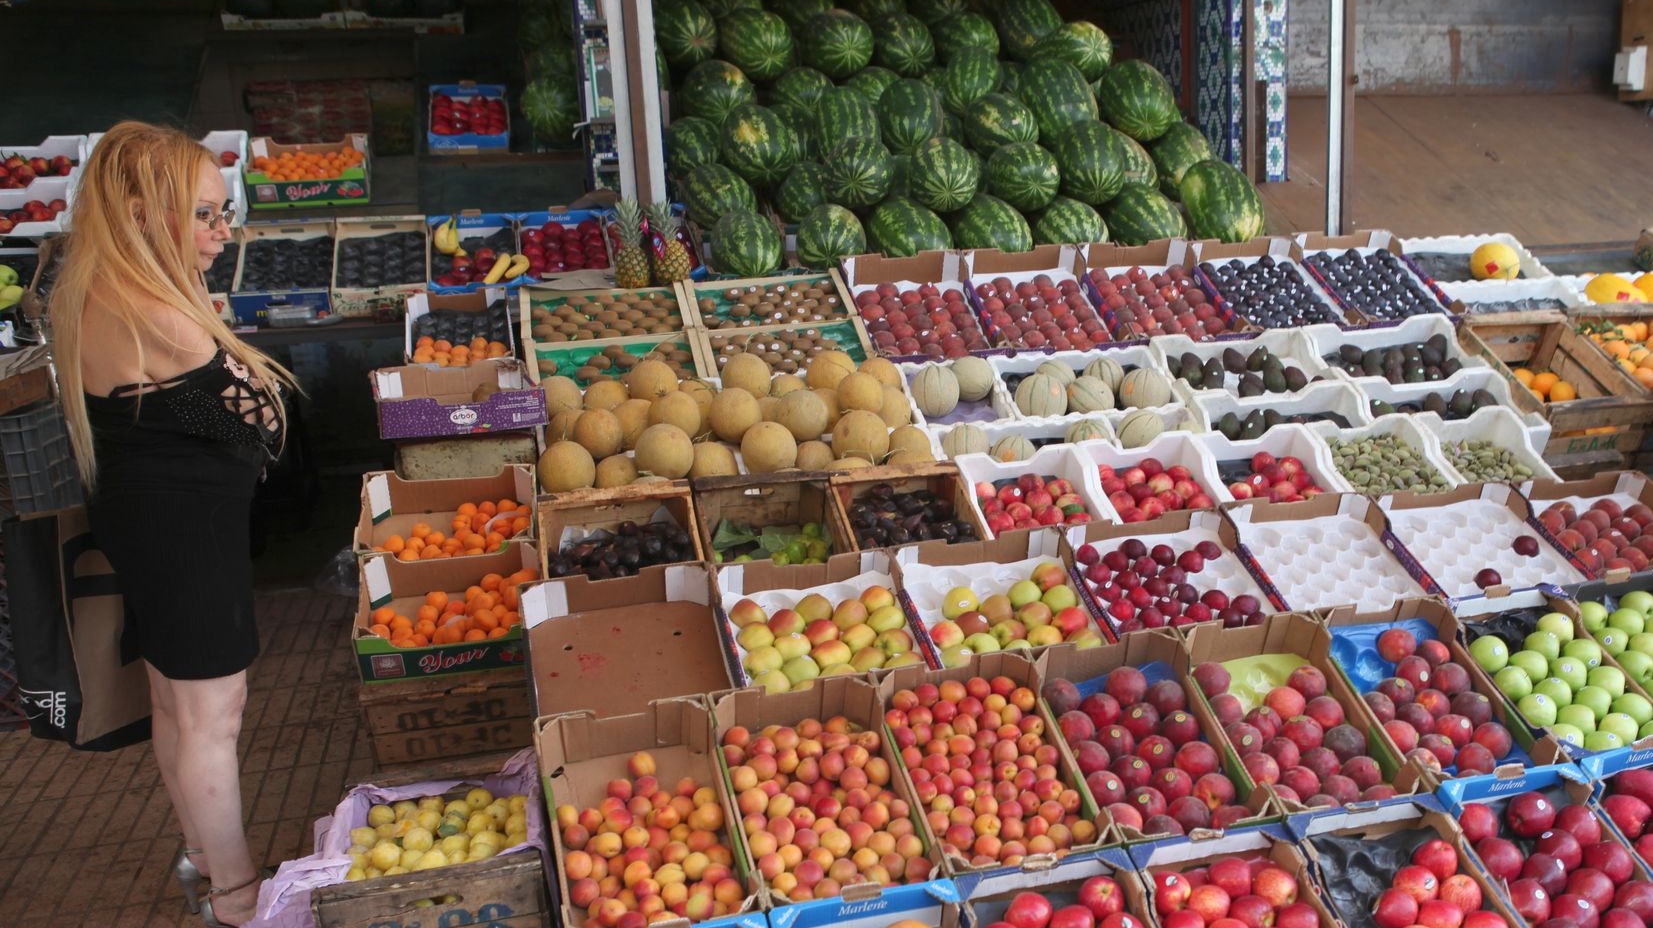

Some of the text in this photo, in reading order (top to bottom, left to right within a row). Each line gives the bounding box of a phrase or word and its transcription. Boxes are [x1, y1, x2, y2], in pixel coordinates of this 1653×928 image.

[418, 646, 490, 674] Your
[54, 691, 67, 729] .com
[1487, 778, 1527, 794] Marlene
[837, 899, 888, 917] Marlene
